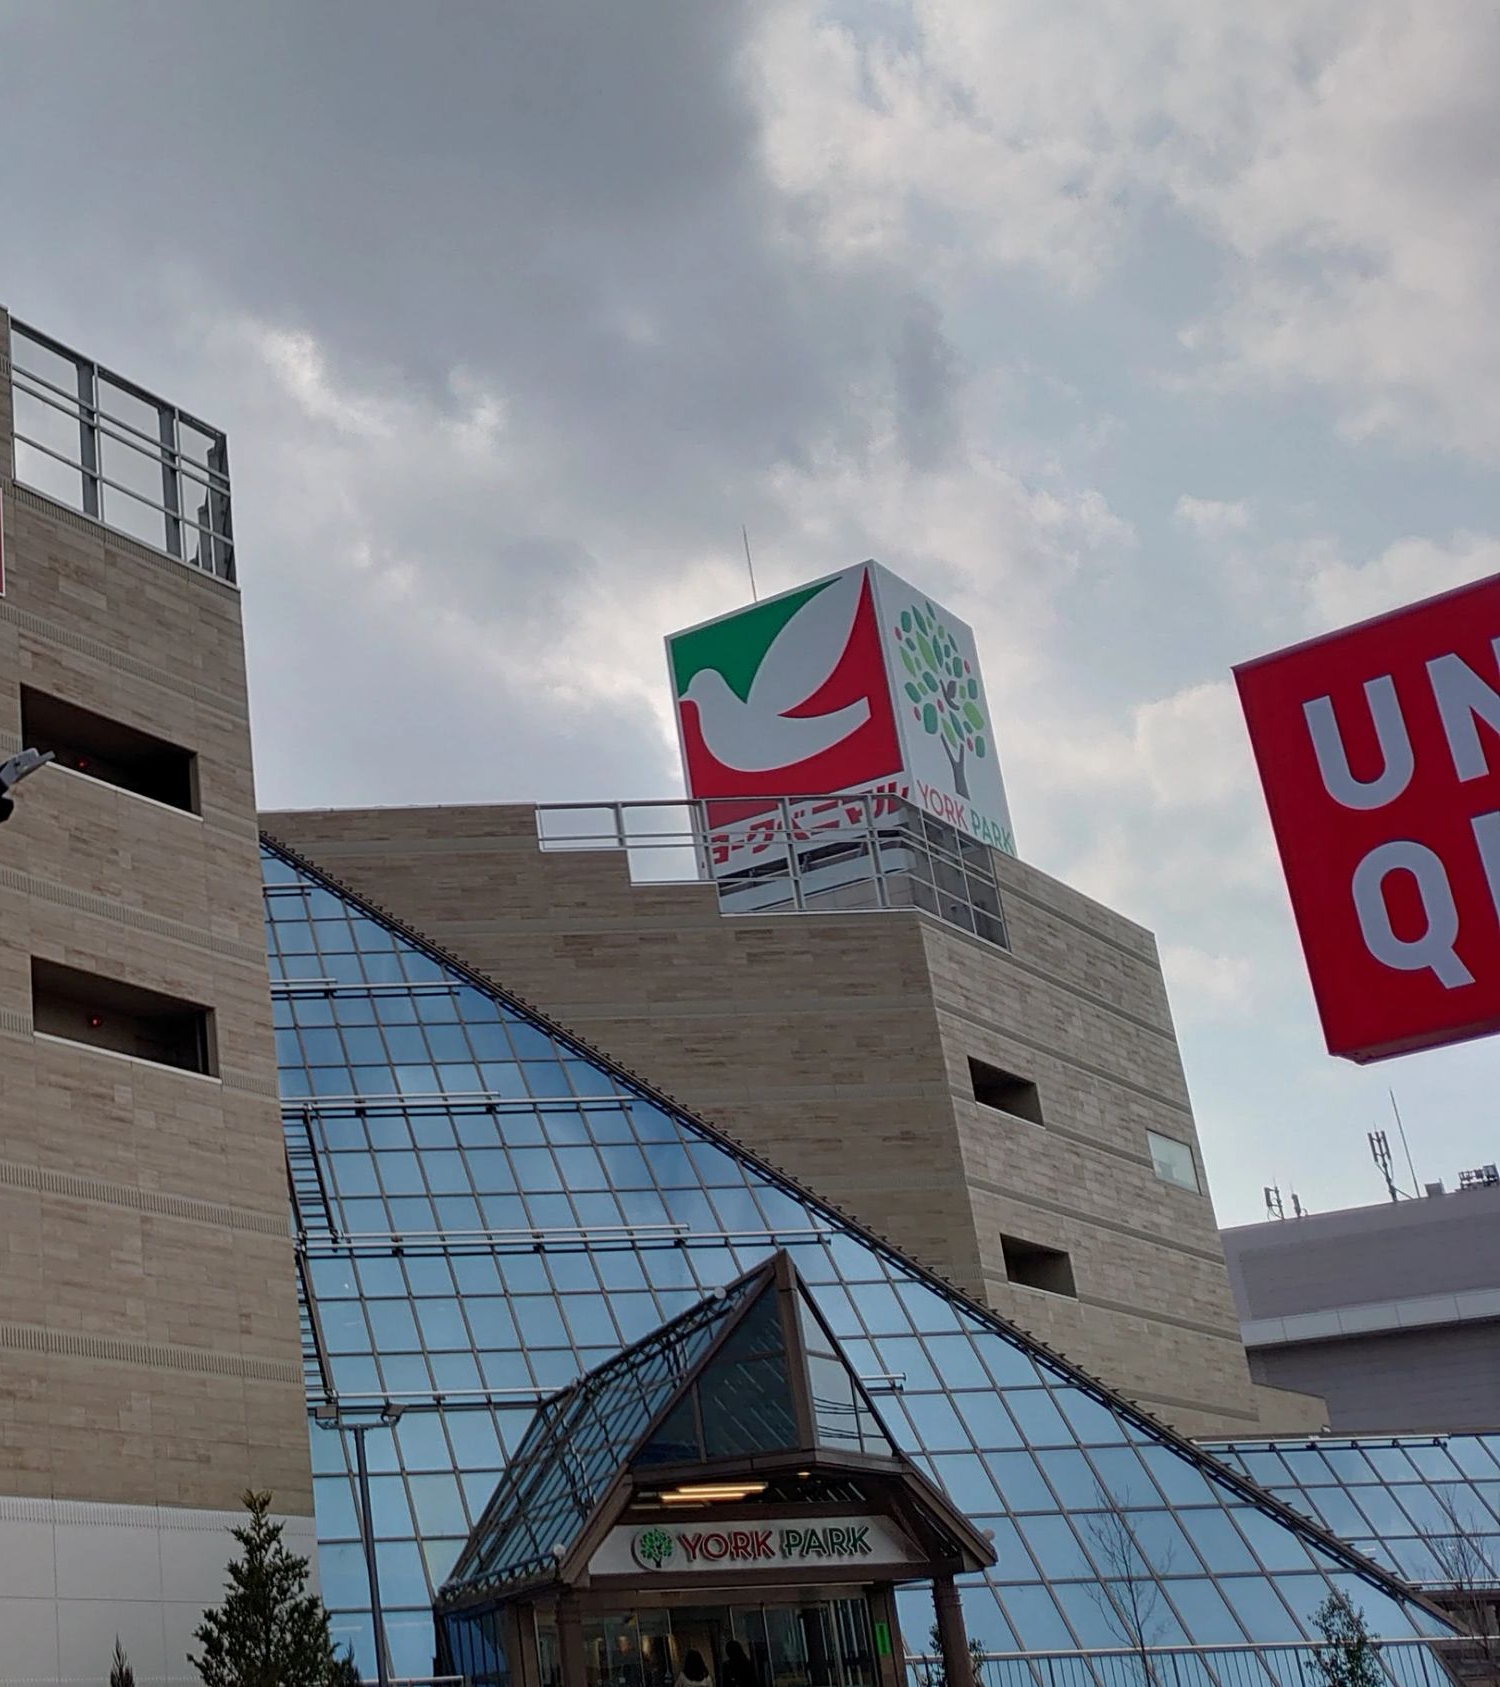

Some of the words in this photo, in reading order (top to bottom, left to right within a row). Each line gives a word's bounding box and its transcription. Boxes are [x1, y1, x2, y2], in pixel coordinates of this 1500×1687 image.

[917, 779, 969, 832] YORK
[970, 809, 1015, 857] PARK
[677, 1530, 776, 1562] YORK
[781, 1526, 873, 1558] PARK
